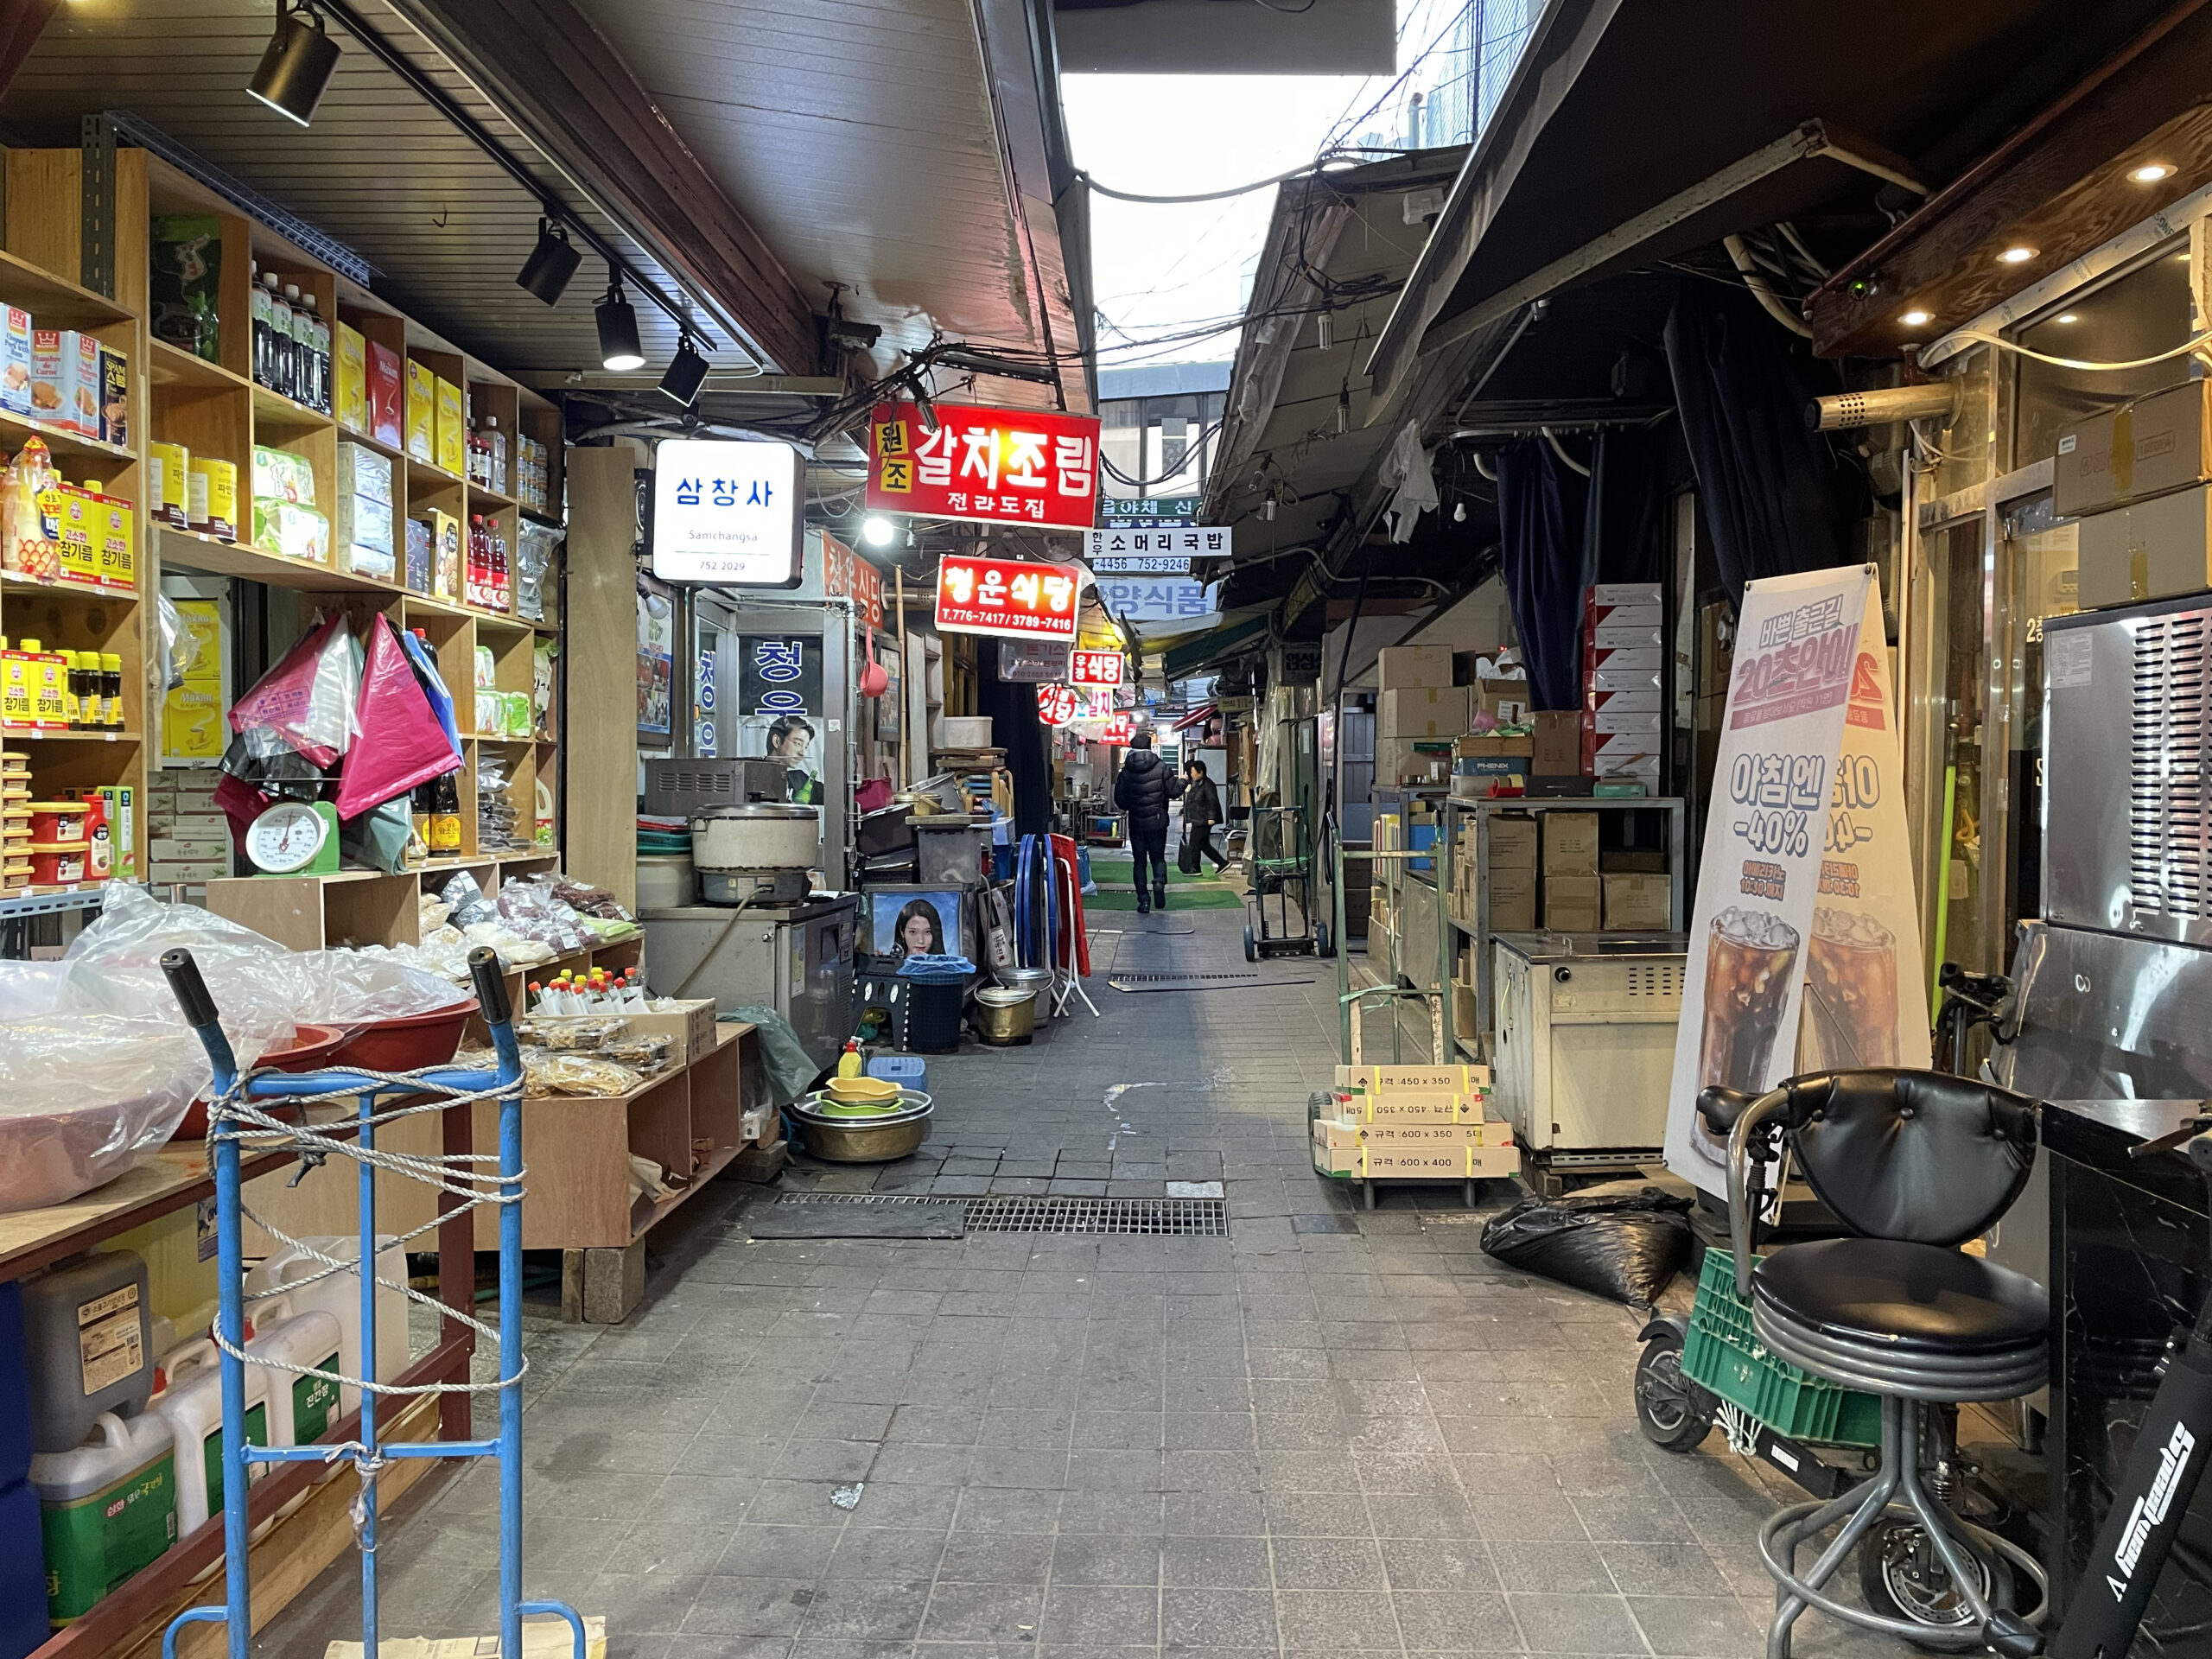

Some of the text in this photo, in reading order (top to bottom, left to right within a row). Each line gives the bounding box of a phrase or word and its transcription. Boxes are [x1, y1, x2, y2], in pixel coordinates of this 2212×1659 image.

[105, 360, 126, 376] SPAM
[881, 424, 907, 490] 원조
[914, 424, 1093, 498] 갈치조림
[677, 477, 773, 508] 삼창사
[947, 492, 1046, 519] 전라도집
[65, 529, 87, 543] 고소한
[105, 537, 126, 552] 고소한
[689, 529, 758, 544] Samchangsa
[1092, 531, 1103, 556] 한우
[60, 540, 93, 563] 참기름
[101, 549, 132, 570] 참기름
[700, 561, 746, 571] 752 2029
[1138, 558, 1190, 570] 752-9246
[1759, 593, 1844, 649] 바쁜 출근길
[1087, 654, 1120, 682] 식당
[3, 696, 30, 712] 참기름
[36, 698, 63, 713] 참기름
[1730, 753, 1826, 811] 아침엔
[1733, 809, 1808, 858] -40%
[1742, 859, 1787, 883] 아메리카노
[1740, 877, 1765, 897] 10:30
[1431, 1077, 1451, 1085] 350
[1375, 1130, 1395, 1139] 규격
[1433, 1130, 1452, 1139] 350
[1373, 1158, 1394, 1167] 규격
[1432, 1158, 1452, 1167] 400
[306, 1382, 329, 1408] 진간장
[2114, 1420, 2196, 1580] Speedway
